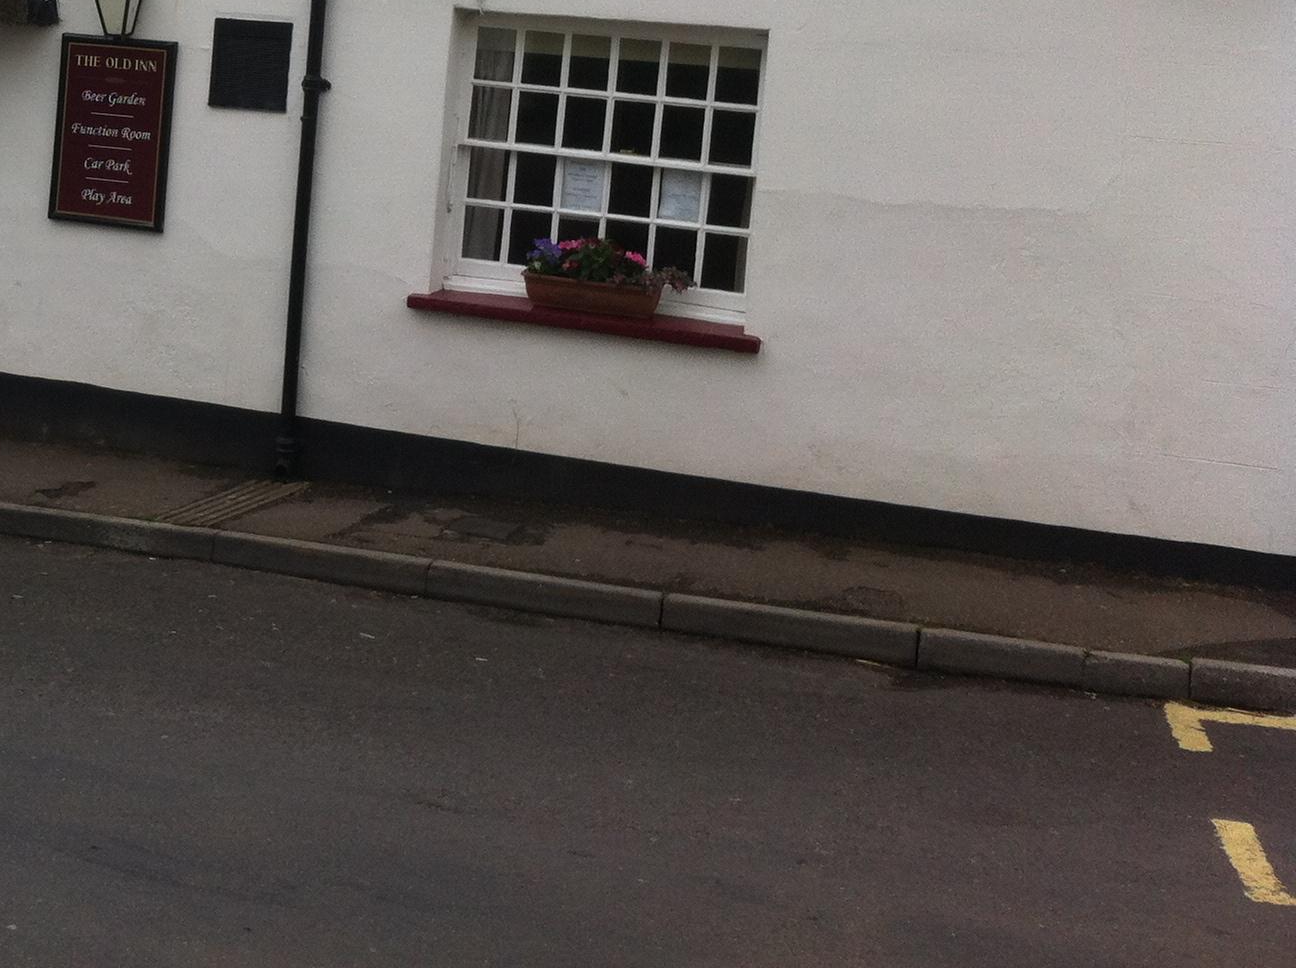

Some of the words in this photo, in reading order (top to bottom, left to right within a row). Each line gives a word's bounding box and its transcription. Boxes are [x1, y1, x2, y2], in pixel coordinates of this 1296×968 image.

[76, 54, 101, 68] THE
[105, 56, 132, 71] OLD
[134, 59, 158, 73] INN
[81, 89, 107, 102] Beer
[108, 92, 147, 108] Garden
[71, 122, 119, 138] Function
[120, 127, 152, 141] Room
[83, 157, 103, 170] Car
[105, 159, 133, 175] Park
[81, 188, 105, 206] Play
[106, 191, 133, 205] Area
